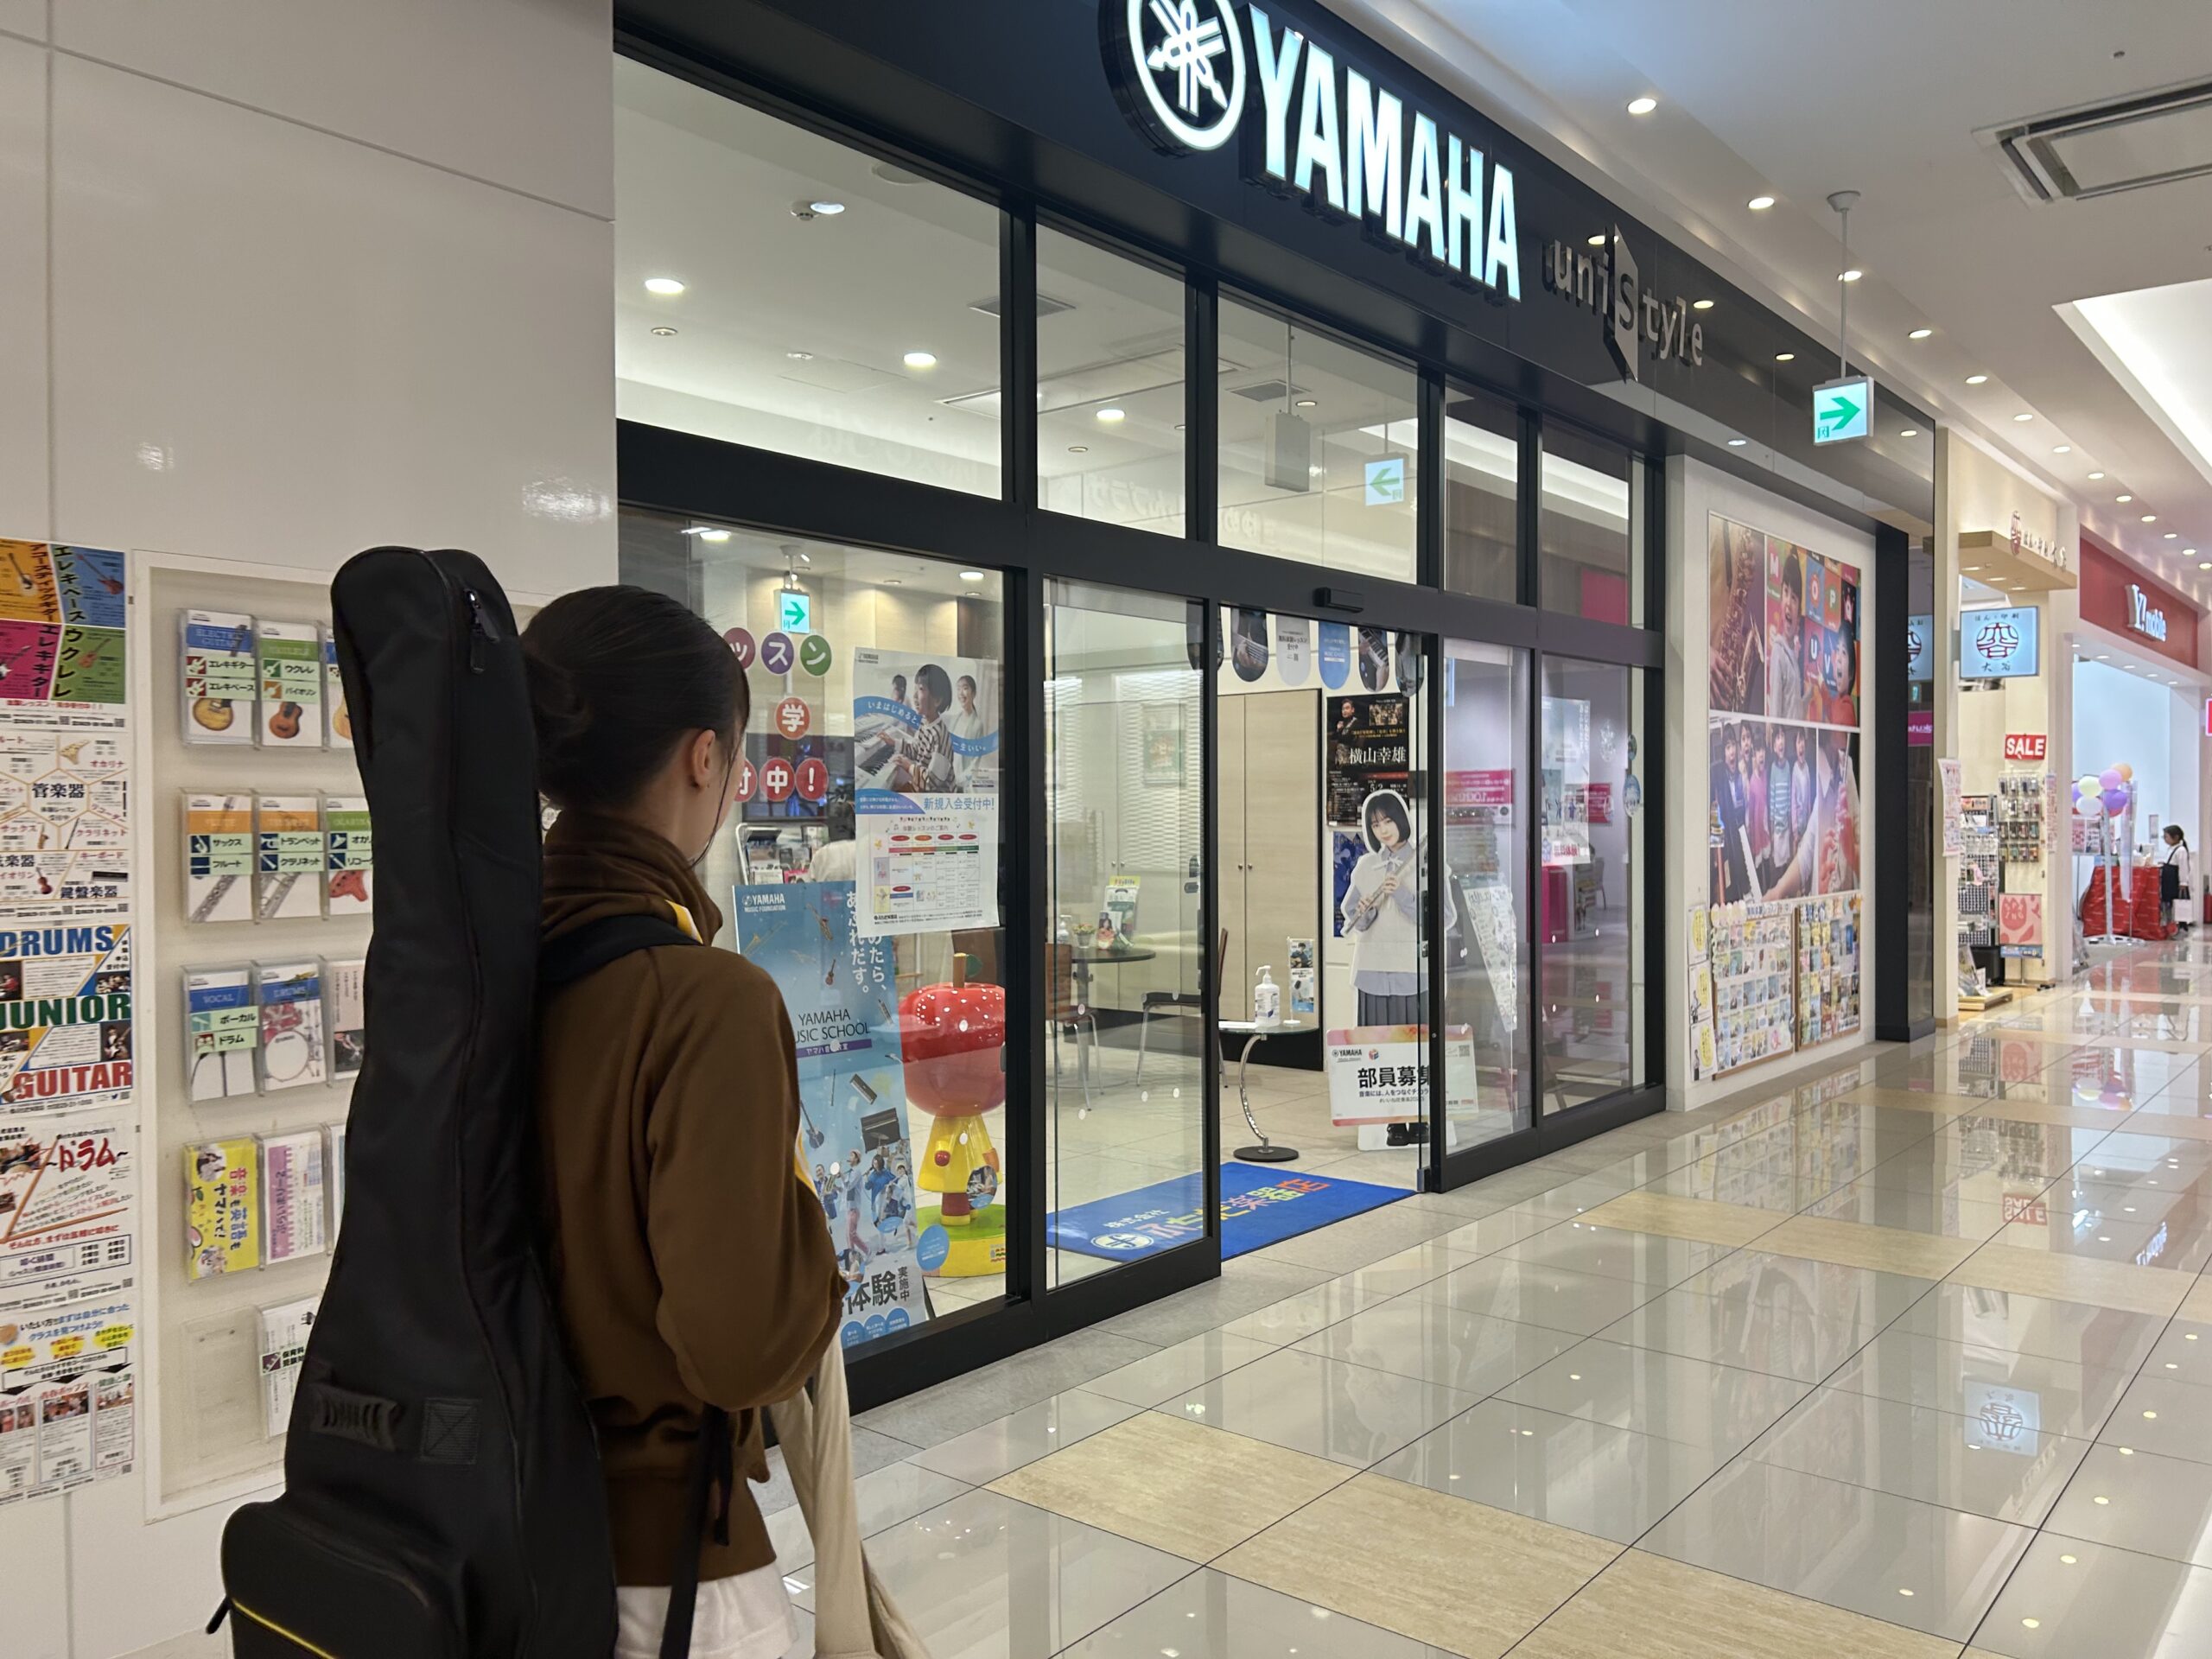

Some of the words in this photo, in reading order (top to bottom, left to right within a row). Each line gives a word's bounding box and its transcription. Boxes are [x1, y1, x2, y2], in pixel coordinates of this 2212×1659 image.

[1249, 3, 1521, 302] YAMAHA
[54, 628, 84, 697] ウクレレ
[284, 664, 315, 674] ウクレレ
[208, 683, 255, 692] エレキベース
[781, 703, 804, 732] 学
[868, 700, 919, 727] いまはじめると、
[1349, 746, 1407, 765] 横山幸雄
[2006, 738, 2045, 757] SALE
[32, 782, 86, 798] 管楽器
[924, 797, 995, 811] 新規入会受付中!
[281, 836, 321, 846] トランペット
[213, 860, 242, 868] フルート
[281, 856, 321, 865] クラリネット
[753, 893, 785, 905] YAMAHA
[0, 925, 114, 957] DRUMS
[203, 995, 235, 1005] VOCAL
[219, 1013, 256, 1025] ボーカル
[798, 1008, 851, 1026] YAMAHA
[822, 1022, 871, 1039] SCHOOL
[219, 1034, 245, 1046] ドラム
[12, 1061, 131, 1100] GUITAR
[229, 1166, 249, 1251] 音楽も英語も
[897, 1266, 910, 1302] 実施中
